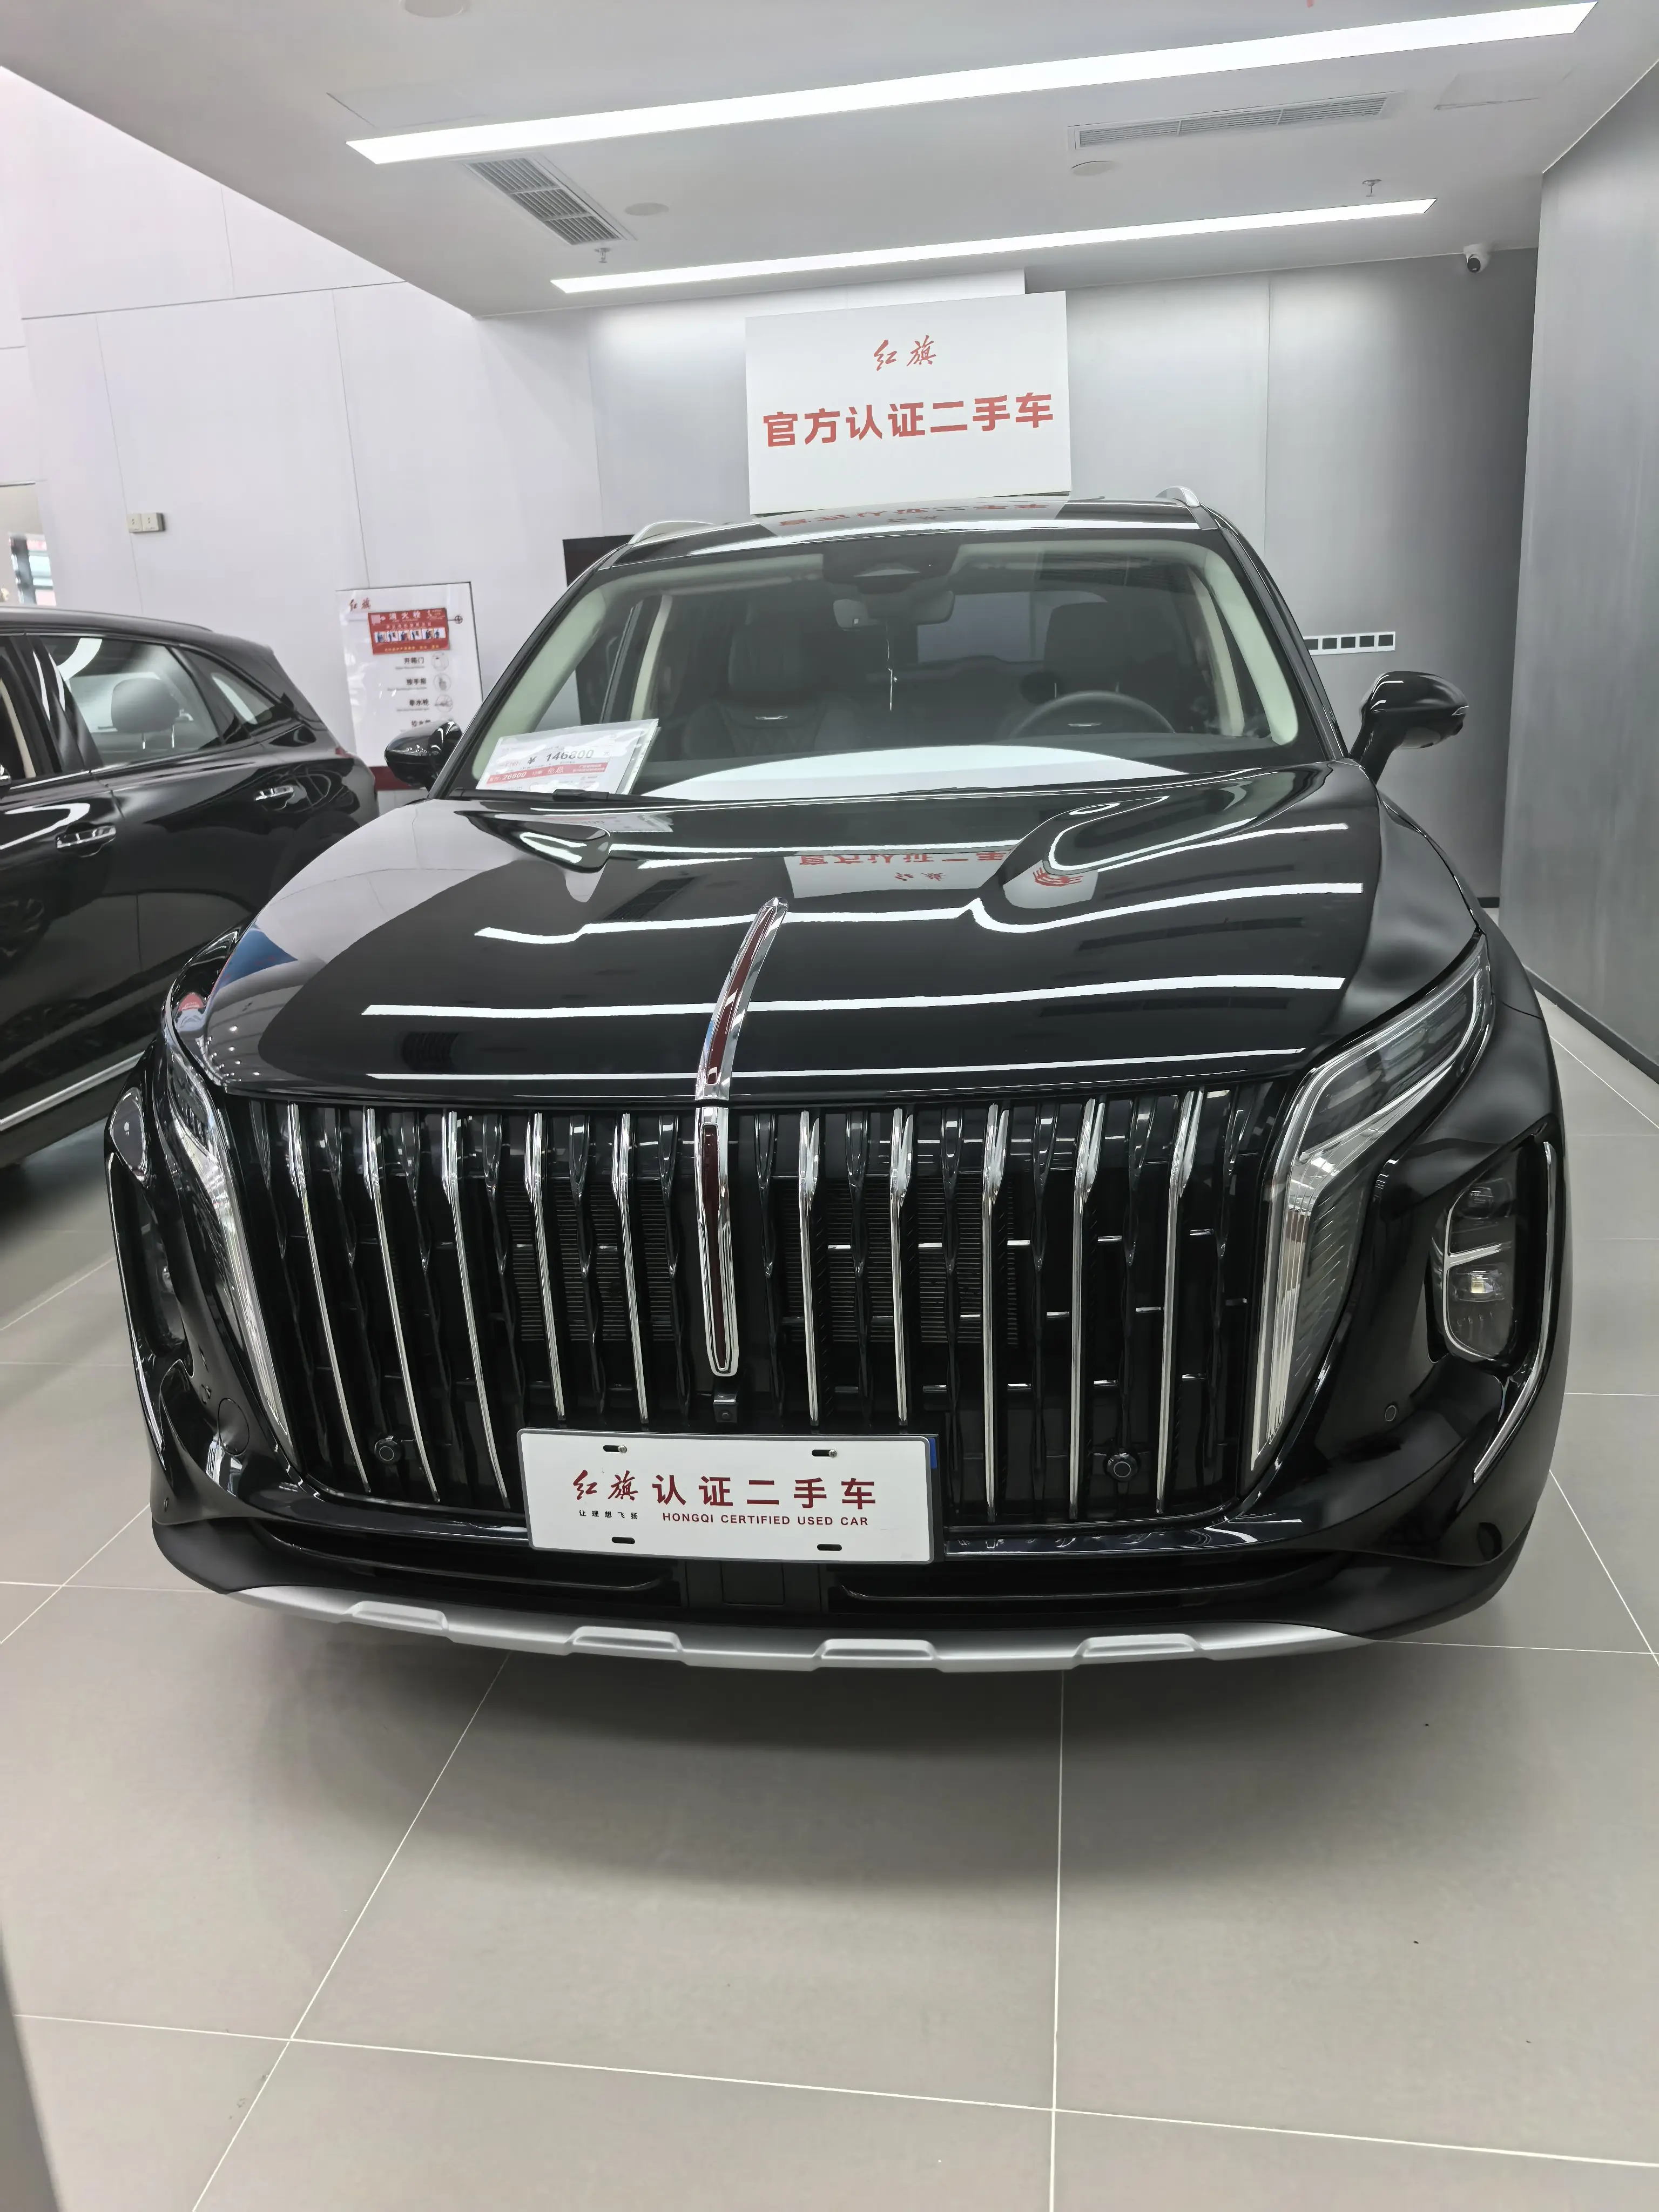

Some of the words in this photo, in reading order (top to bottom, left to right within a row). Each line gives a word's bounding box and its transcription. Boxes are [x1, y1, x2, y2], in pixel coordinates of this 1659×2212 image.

[873, 335, 936, 372] 红旗
[763, 392, 1054, 448] 官方认证二手车
[546, 749, 595, 762] 146800
[572, 1469, 639, 1501] 红旗
[652, 1474, 876, 1510] 认证二手车
[578, 1509, 639, 1520] 让理想飞扬
[662, 1512, 714, 1523] HONGQI
[720, 1514, 791, 1526] CERTIFIED
[797, 1516, 834, 1526] USED
[840, 1517, 869, 1527] CAR
